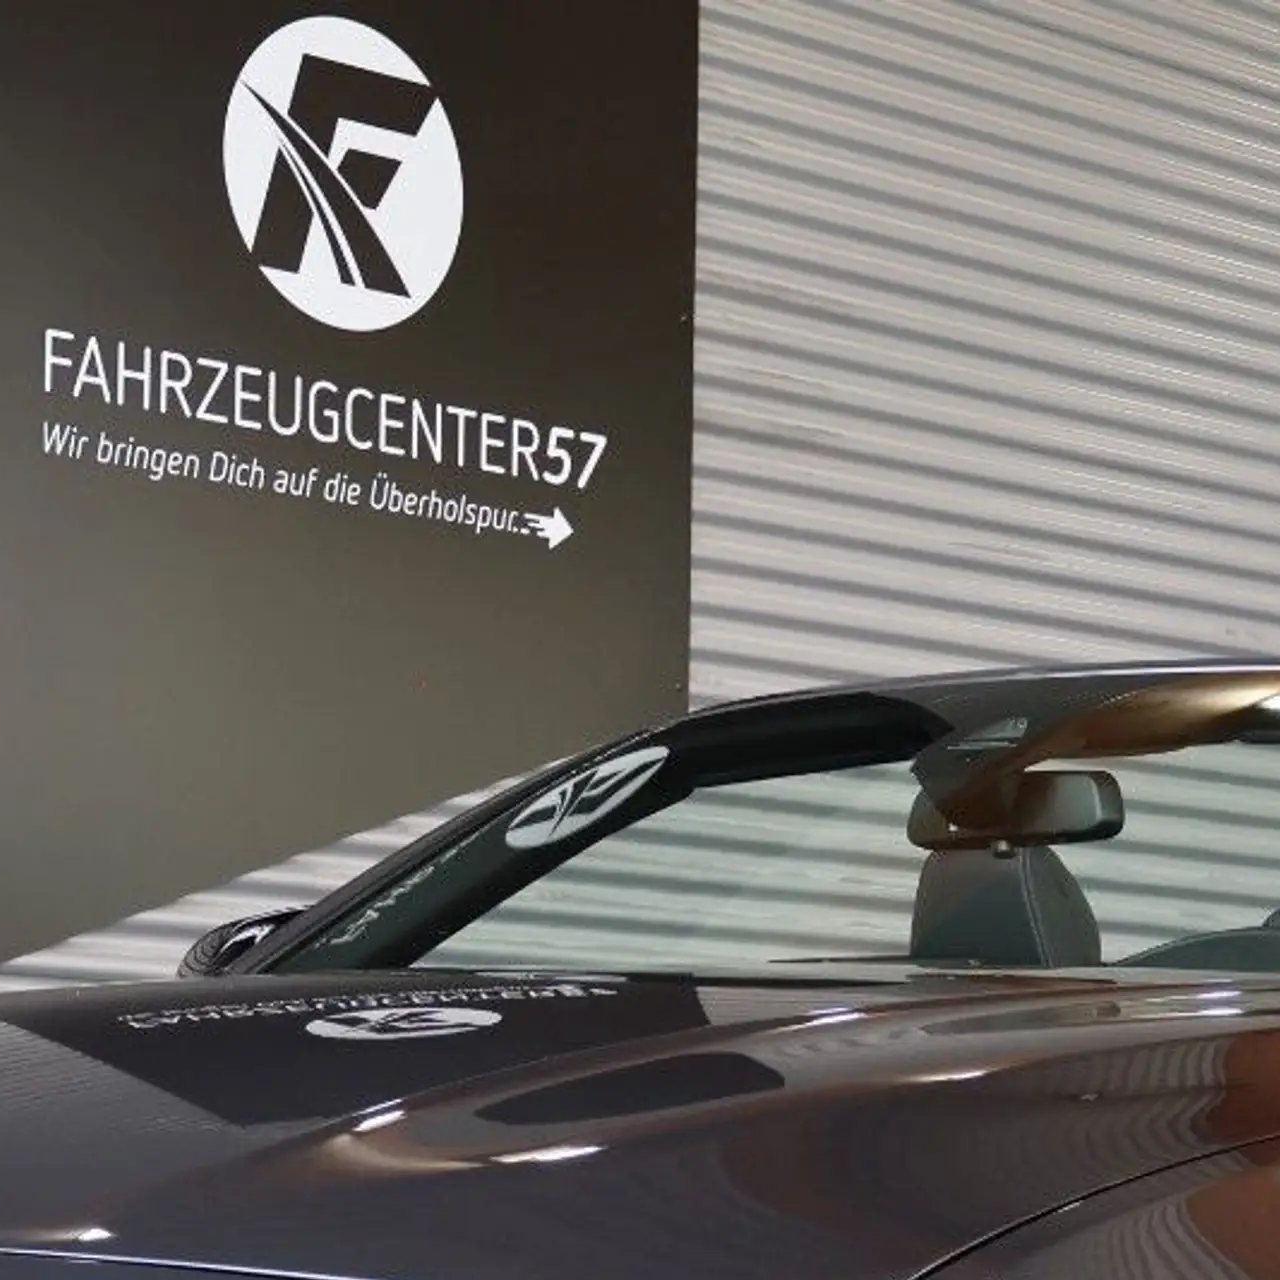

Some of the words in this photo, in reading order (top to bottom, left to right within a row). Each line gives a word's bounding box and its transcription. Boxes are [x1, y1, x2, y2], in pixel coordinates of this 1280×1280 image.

[42, 420, 89, 460] Wir
[96, 431, 200, 481] bringen
[208, 450, 265, 489] Dich
[272, 467, 318, 498] auf
[323, 473, 361, 505] die
[44, 329, 608, 489] FAHRZEUGCENTER57
